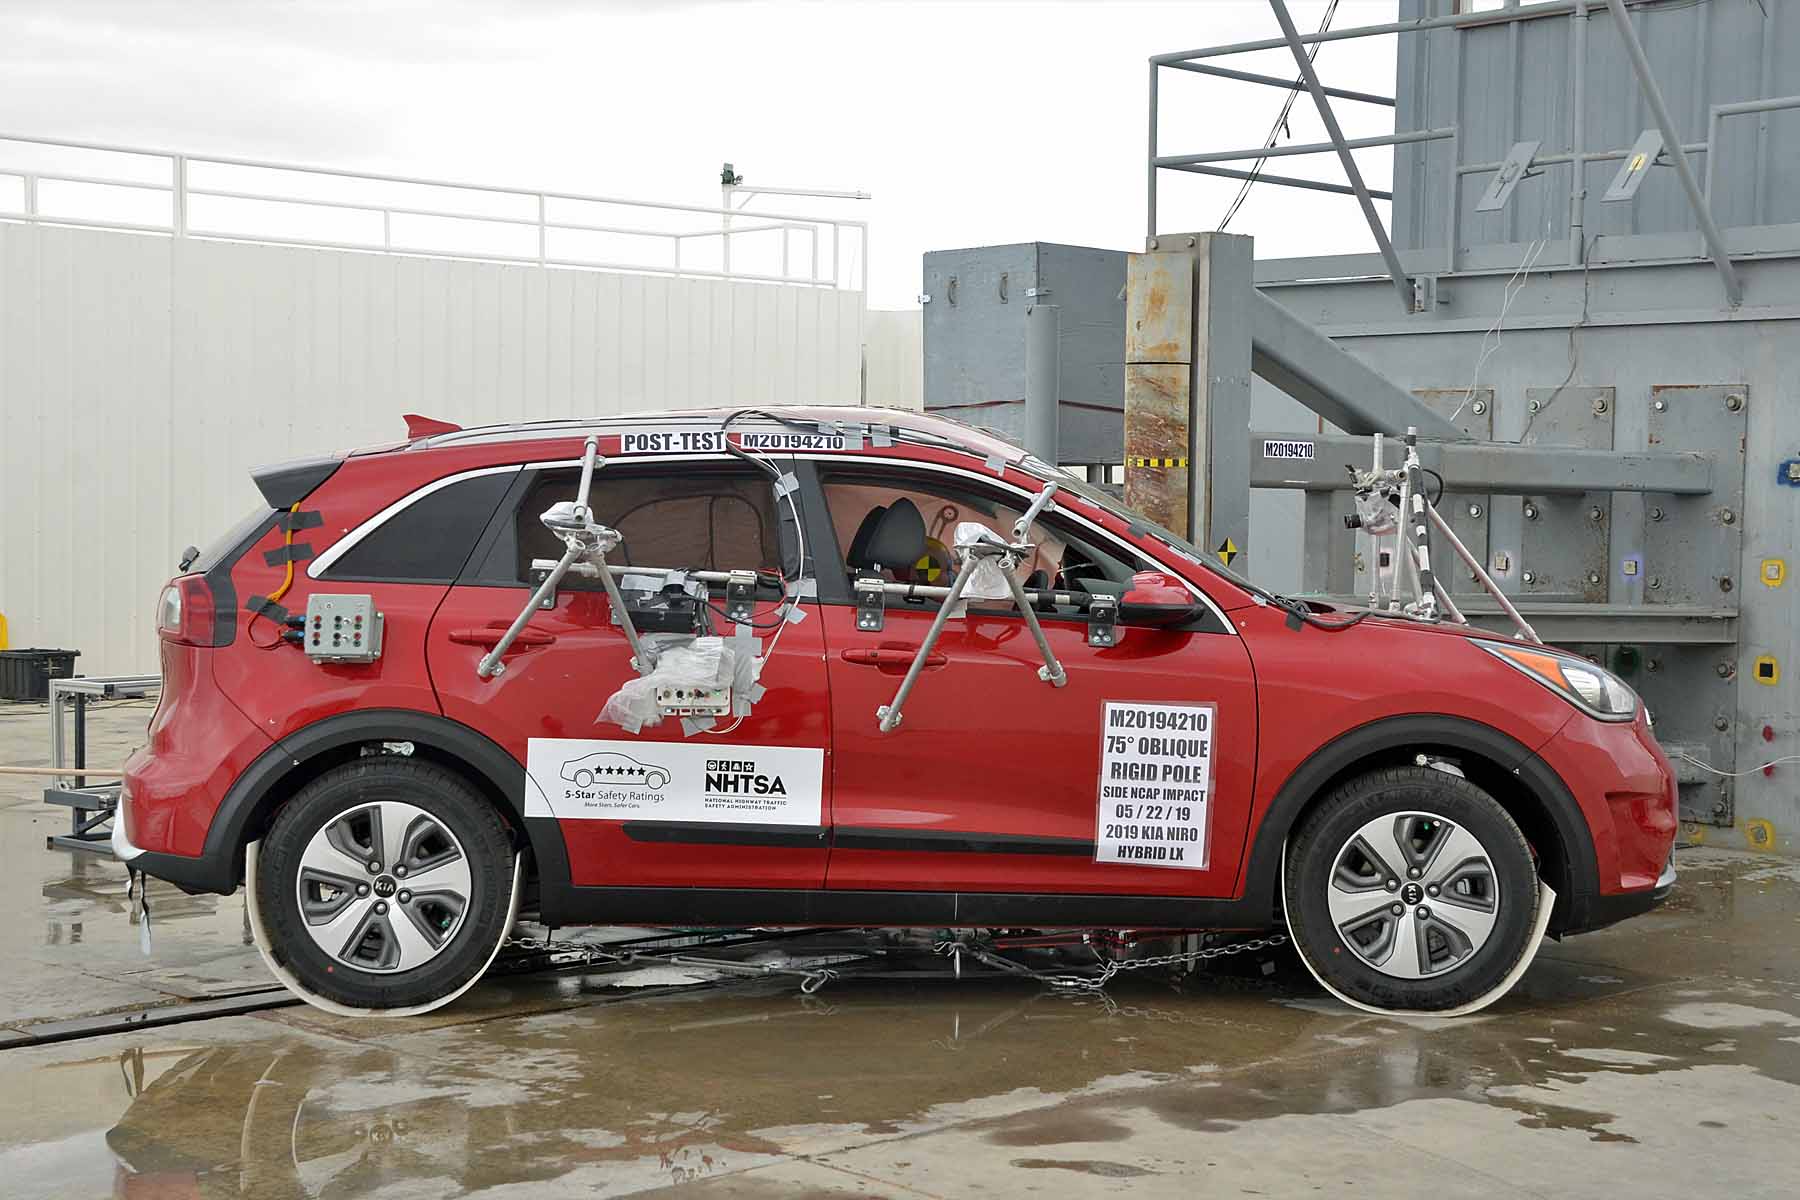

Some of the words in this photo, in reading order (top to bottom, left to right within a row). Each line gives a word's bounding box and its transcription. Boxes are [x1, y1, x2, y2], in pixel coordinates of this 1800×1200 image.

[624, 432, 724, 450] POST-TEST
[743, 435, 843, 449] M20194210
[1265, 442, 1313, 457] M20194210
[1110, 709, 1207, 731] M20194210
[1107, 735, 1135, 754] 75°
[1138, 737, 1208, 759] OBLIQUE
[1110, 762, 1158, 782] RIGID
[1162, 765, 1202, 784] POLE
[705, 773, 787, 795] NHTSA
[564, 790, 596, 799] 5-Star
[598, 790, 627, 802] Safety
[629, 791, 665, 803] Ratings
[1103, 786, 1129, 799] SIDE
[1130, 787, 1160, 800] NCAP
[1163, 789, 1206, 802] IMPACT
[1106, 824, 1139, 840] 2019
[1141, 826, 1164, 841] KIA
[1166, 828, 1198, 842] NIRO
[1117, 845, 1167, 860] HYBRID
[1169, 847, 1184, 861] LX
[375, 881, 394, 892] KIA
[1407, 885, 1417, 903] KIA
